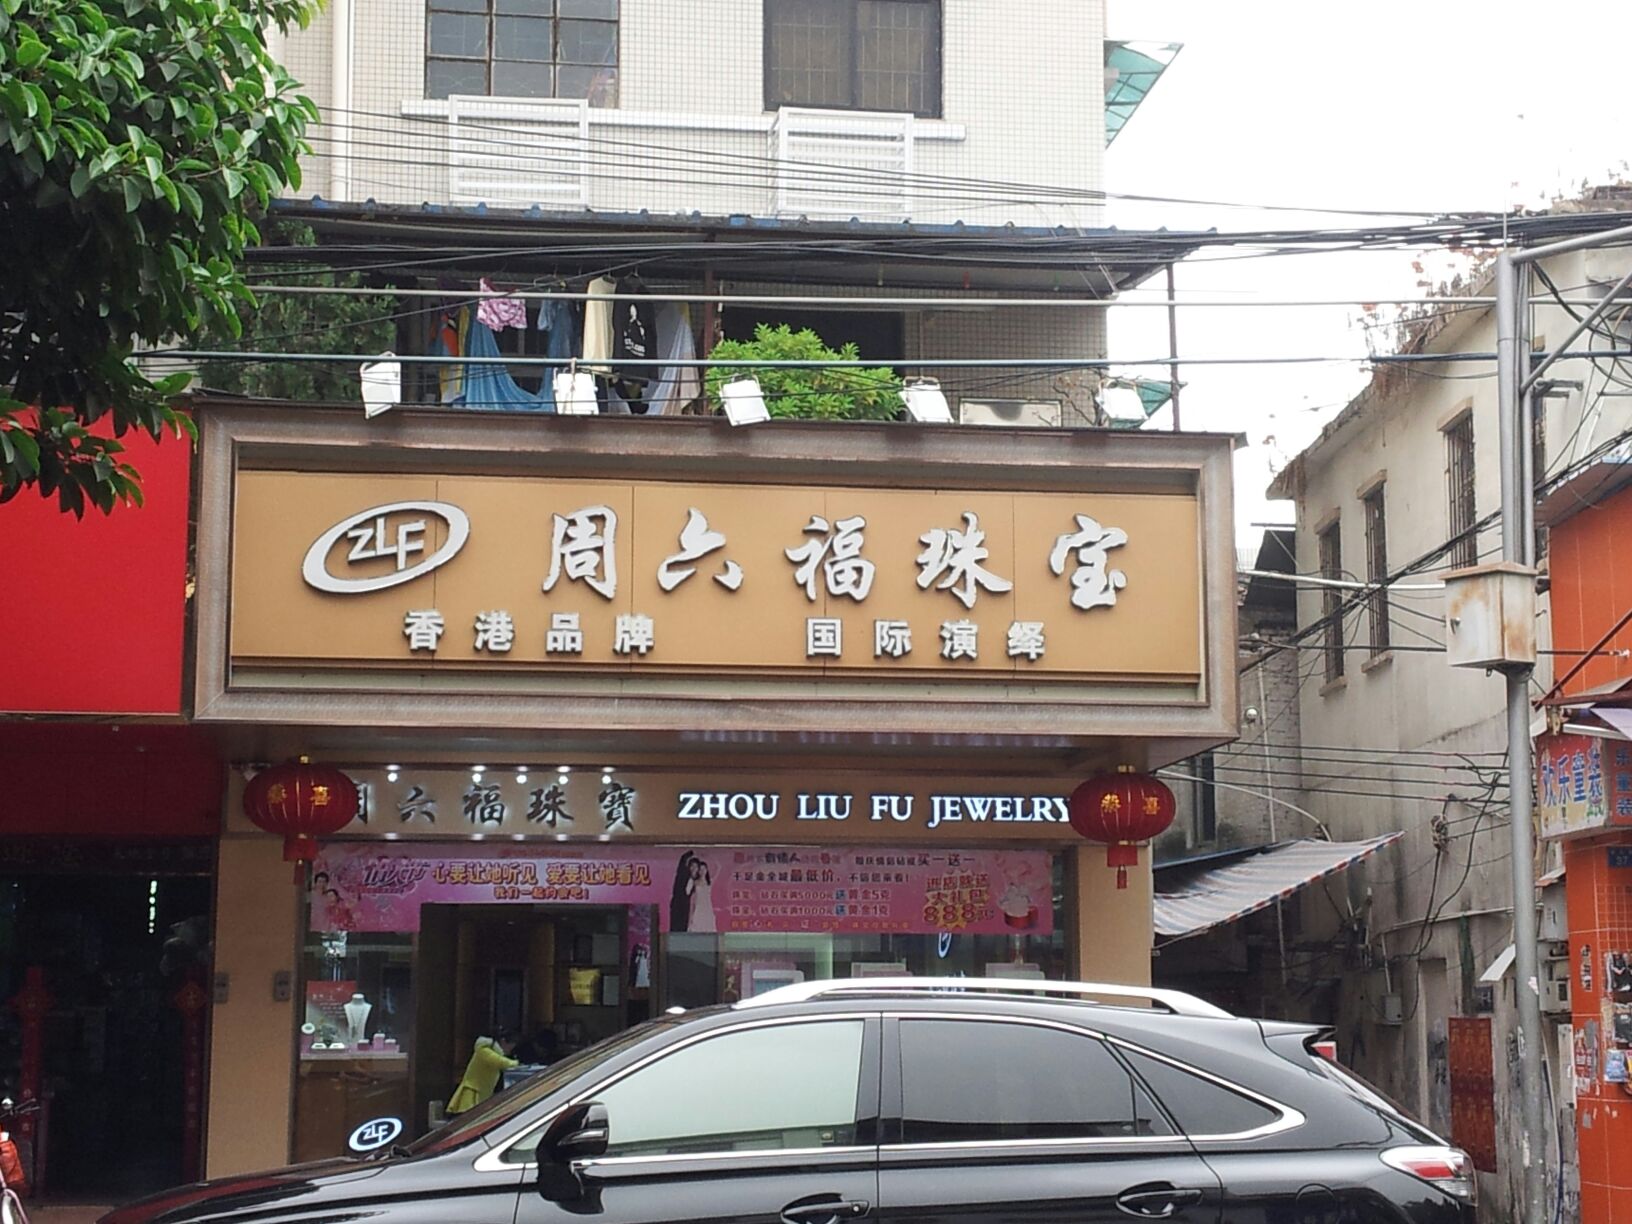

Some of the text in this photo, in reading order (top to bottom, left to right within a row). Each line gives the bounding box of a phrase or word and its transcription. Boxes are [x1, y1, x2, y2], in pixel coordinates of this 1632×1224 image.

[347, 518, 426, 571] ZLF
[542, 504, 1128, 610] 周六福珠宝
[404, 609, 1046, 661] 香港品牌 国际演绎
[1541, 747, 1603, 807] 欢乐童装
[678, 793, 1070, 828] ZHOU LIU FU JEWELRY
[546, 862, 651, 885] 爱要让她看见
[361, 1123, 390, 1143] ZLF
